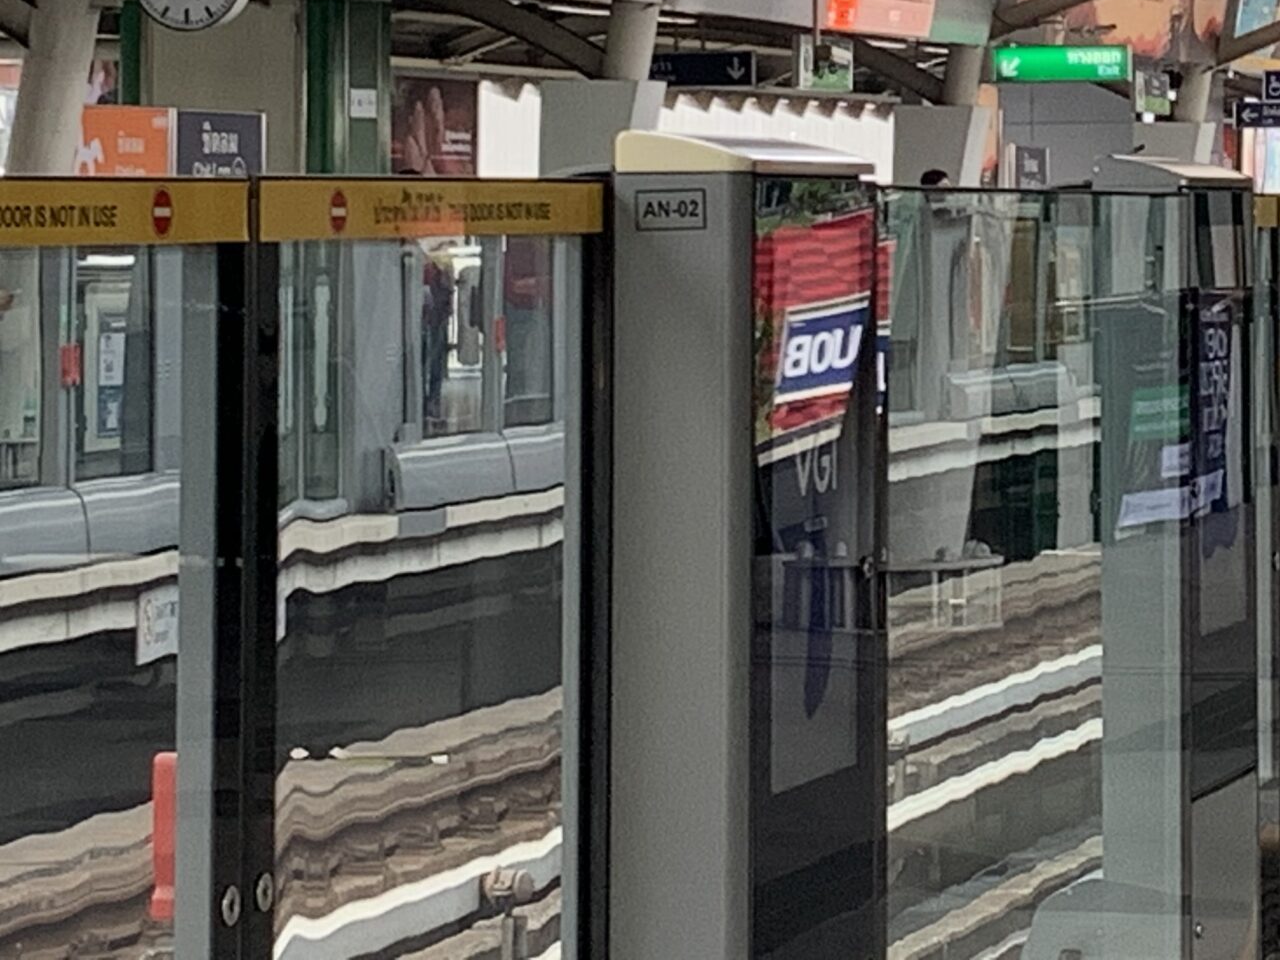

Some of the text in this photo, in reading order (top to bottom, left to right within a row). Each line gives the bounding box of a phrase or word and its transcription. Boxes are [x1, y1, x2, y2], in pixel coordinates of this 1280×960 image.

[1097, 65, 1120, 76] Exit
[0, 205, 32, 228] OOR
[49, 205, 76, 228] NOT
[93, 205, 117, 228] USE
[642, 199, 700, 219] AN-02
